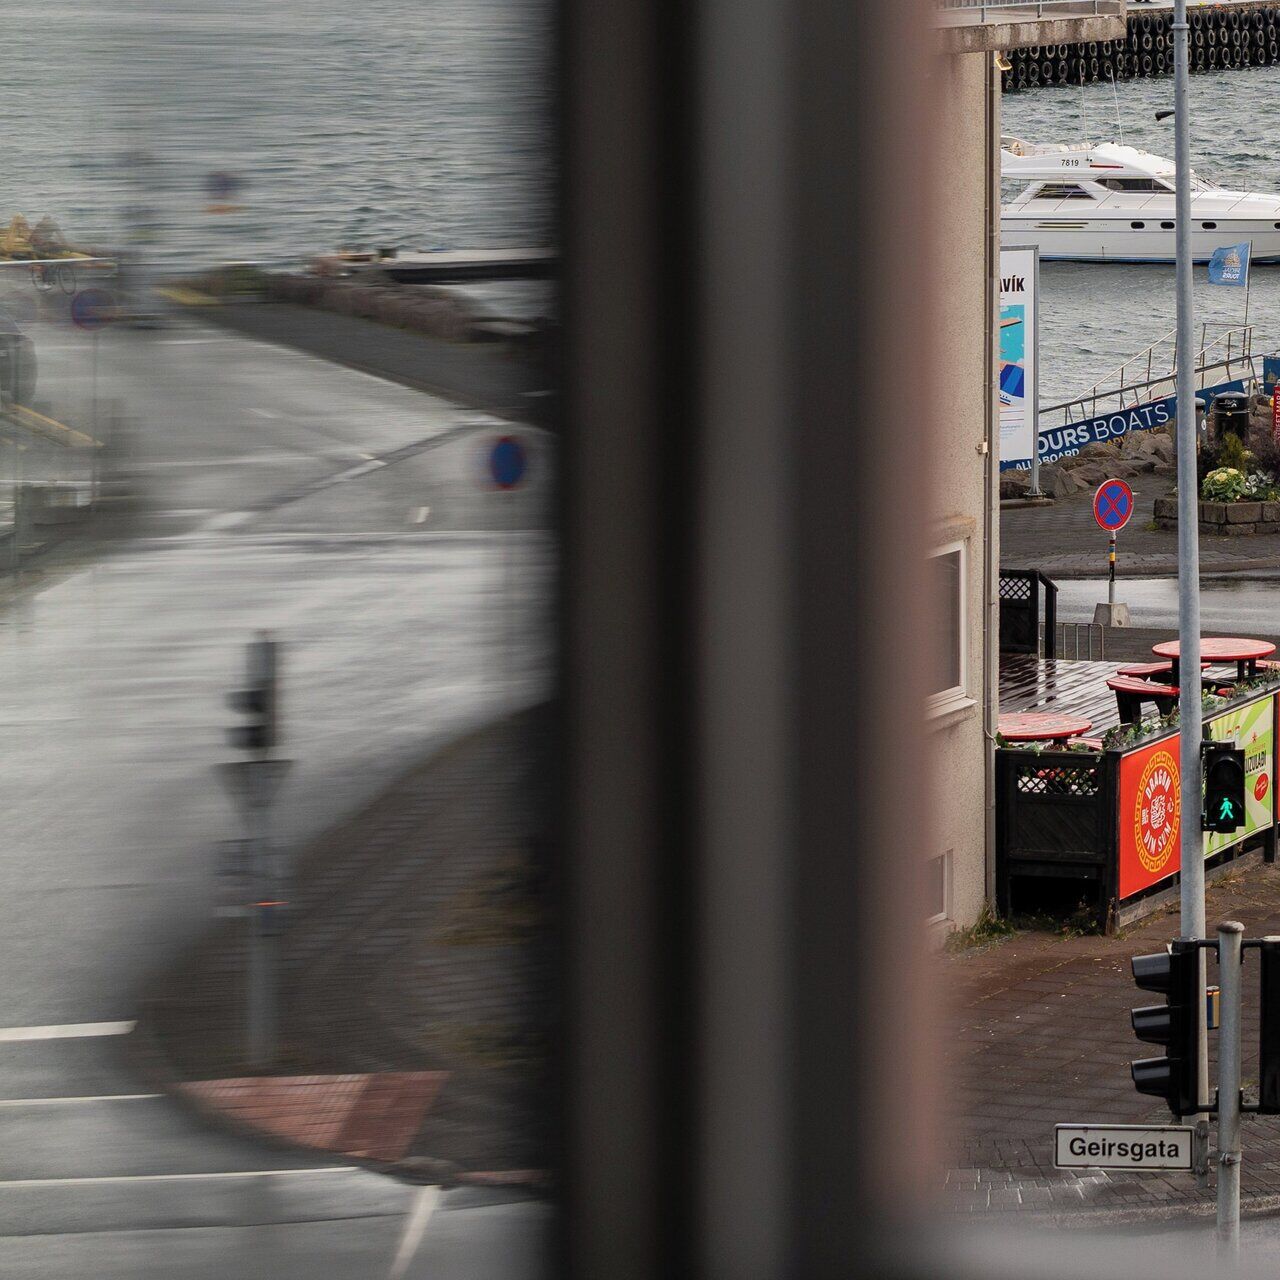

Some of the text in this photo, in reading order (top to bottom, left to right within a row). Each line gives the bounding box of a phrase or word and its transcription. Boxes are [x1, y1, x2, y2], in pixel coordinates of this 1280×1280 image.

[1038, 425, 1091, 454] OURS
[1093, 404, 1169, 440] BOATS
[1145, 769, 1171, 800] DRAGON
[1144, 822, 1172, 855] DIM SUM
[1069, 1137, 1179, 1162] Geirsgata
